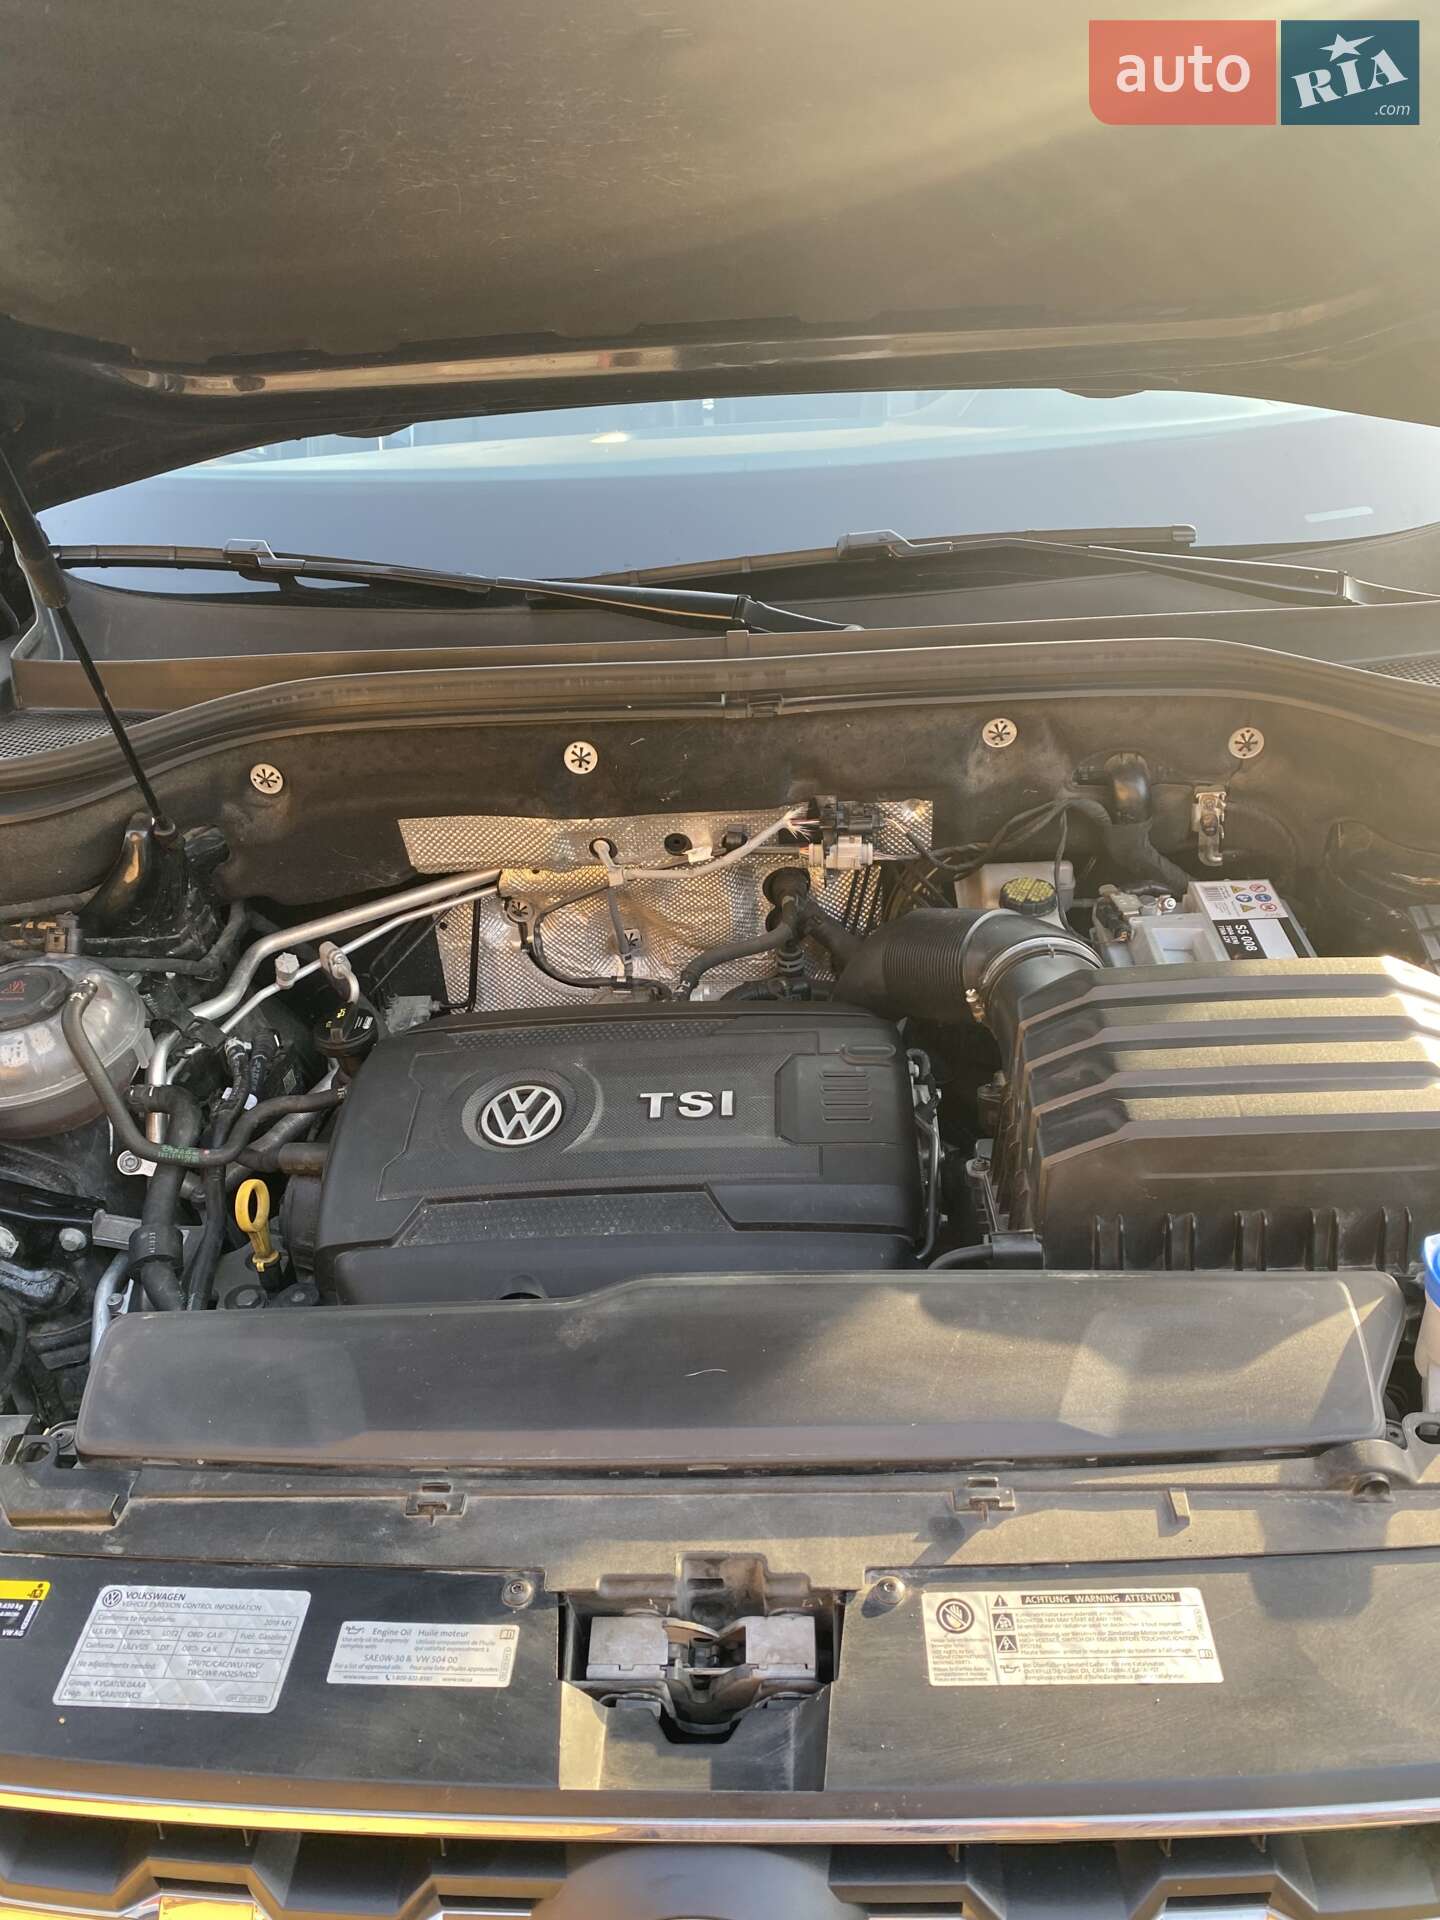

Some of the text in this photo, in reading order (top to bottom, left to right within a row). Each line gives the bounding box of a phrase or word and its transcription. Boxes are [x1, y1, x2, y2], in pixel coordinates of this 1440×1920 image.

[1240, 935, 1258, 951] 008
[640, 1090, 733, 1118] TSI
[126, 1591, 186, 1600] VOLKSWAGEN
[1025, 1593, 1175, 1604] ACHTUNG WARNING ATTENTION
[182, 1602, 212, 1610] CONTROL
[214, 1603, 262, 1612] INFORMATION
[372, 1628, 412, 1637] Engine Oil
[418, 1629, 438, 1637] Huile
[416, 1655, 458, 1664] VW 504 00
